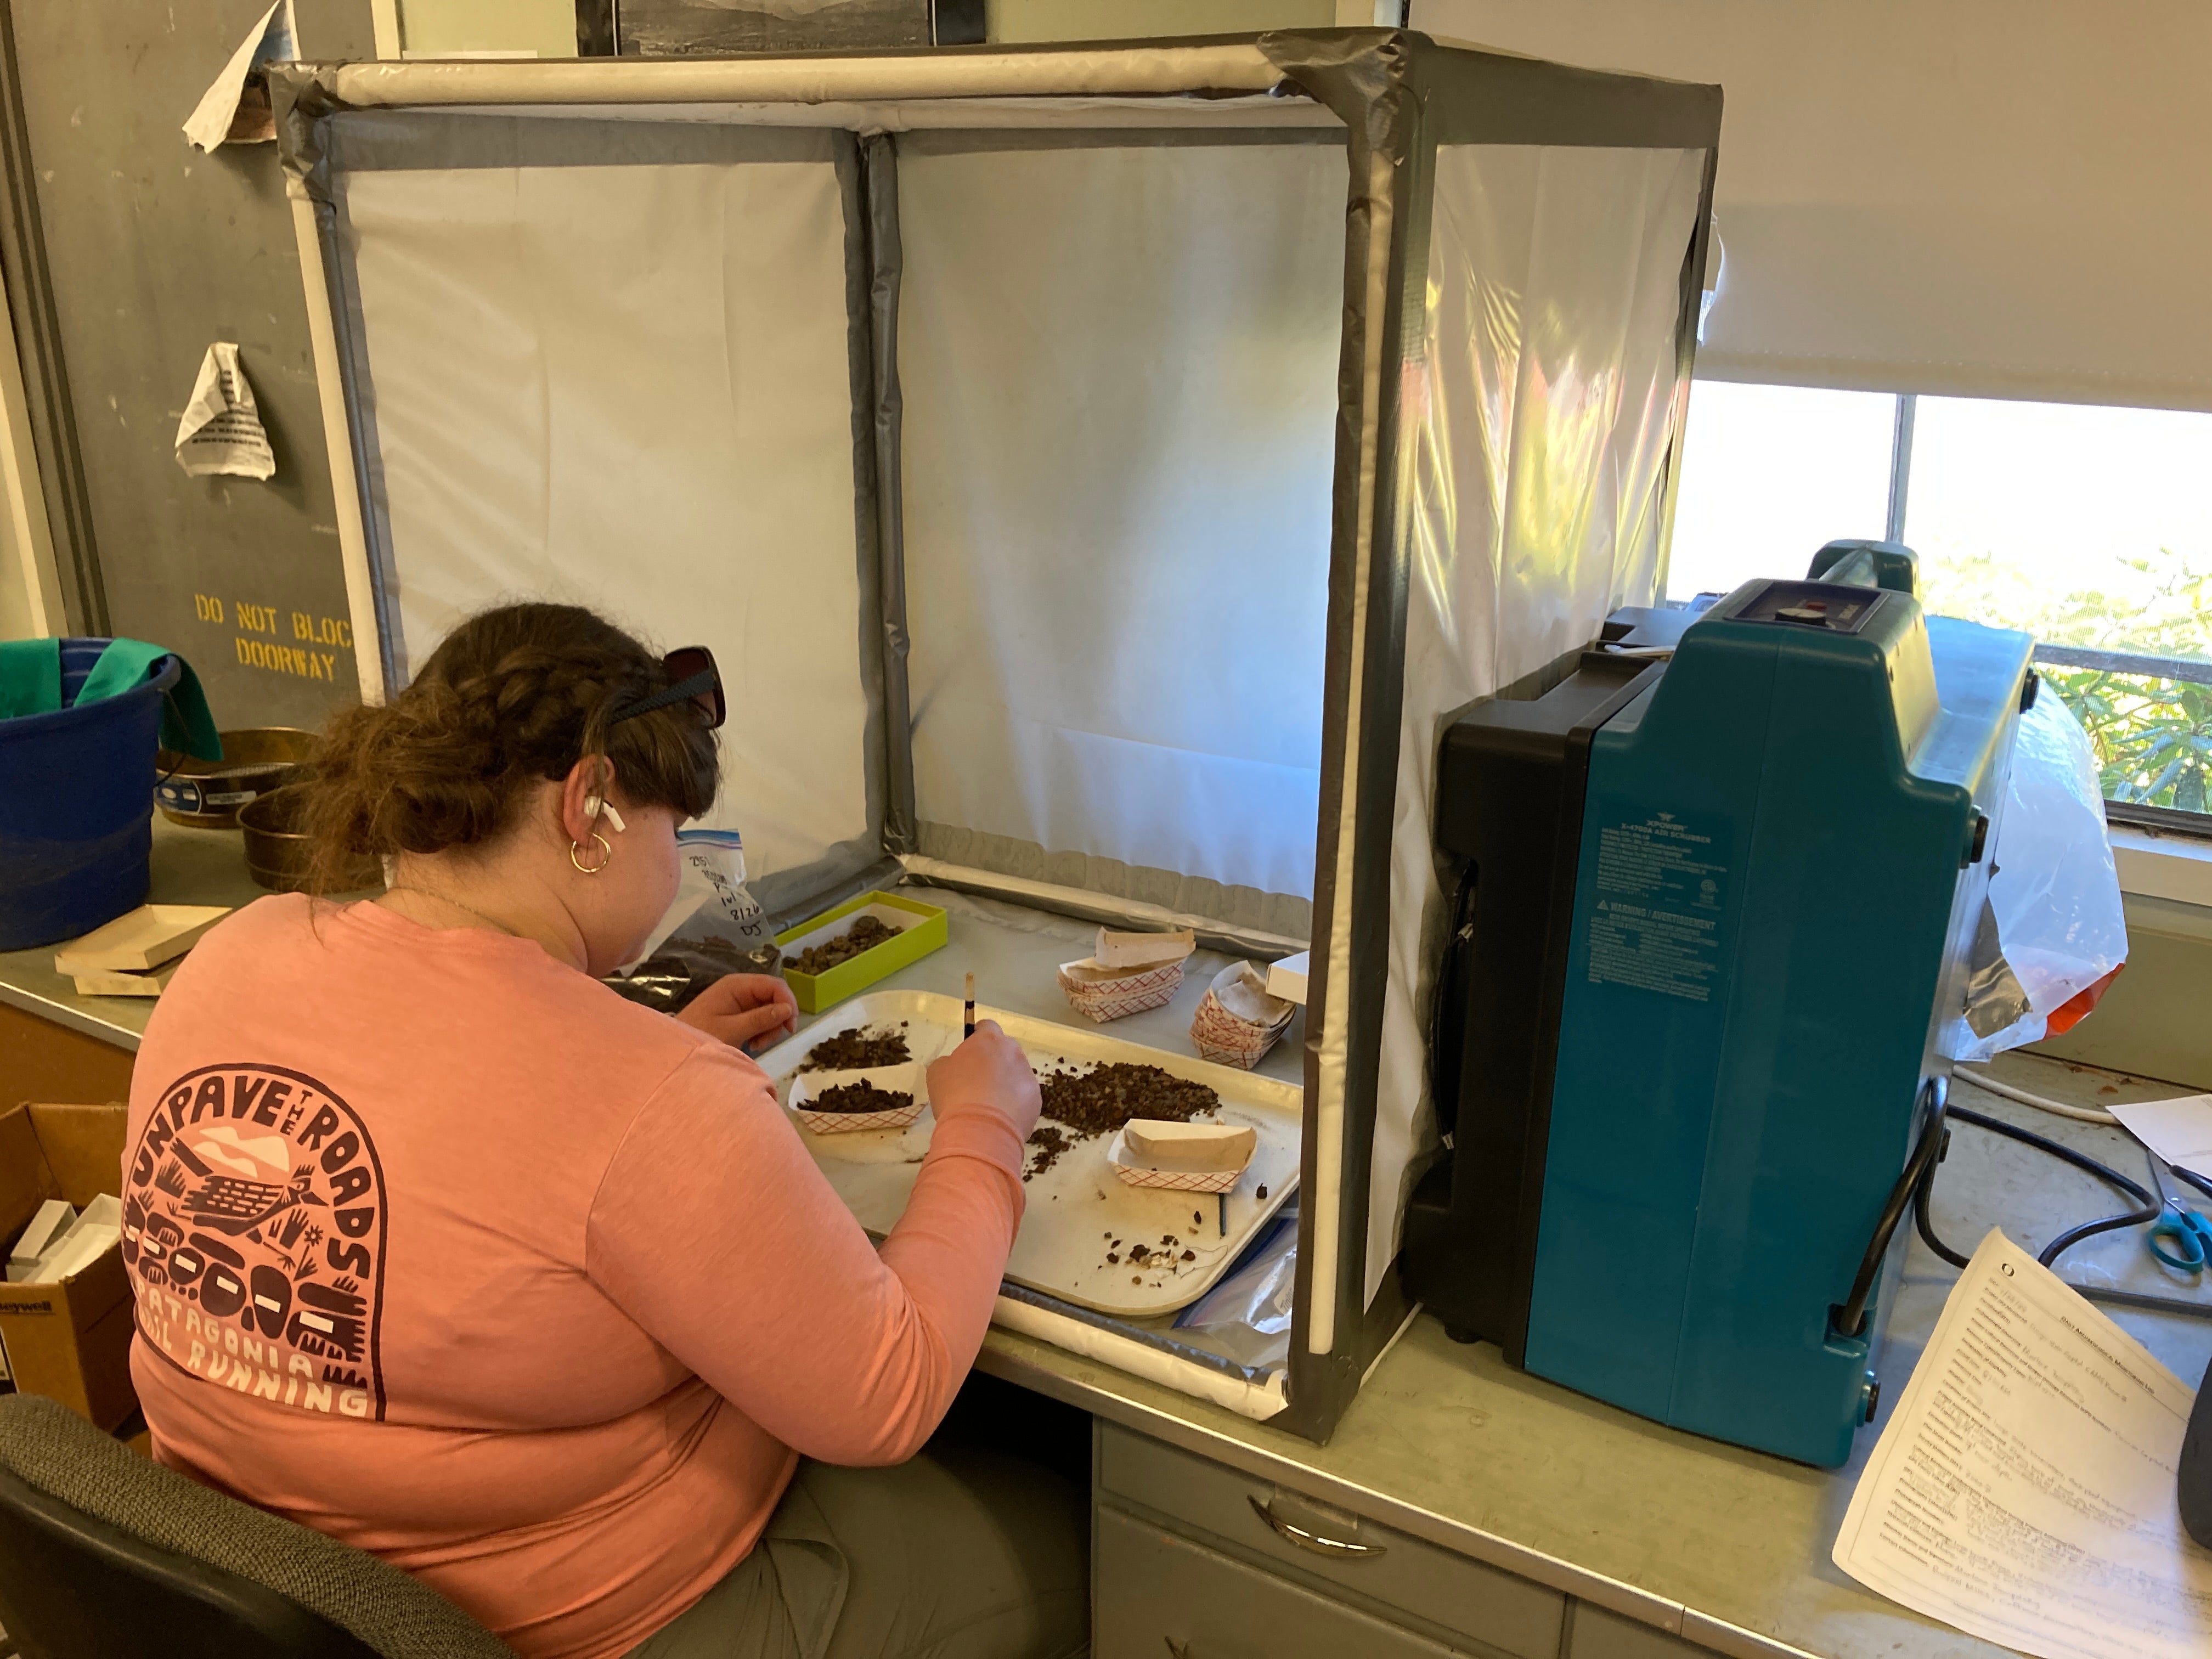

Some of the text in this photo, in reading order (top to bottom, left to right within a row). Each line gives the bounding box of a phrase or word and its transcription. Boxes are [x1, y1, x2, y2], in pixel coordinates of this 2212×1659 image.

[194, 594, 352, 648] DO NOT BLOC
[235, 637, 334, 682] DOORWAY
[132, 1075, 375, 1280] UNPAVE THE ROADS
[137, 1276, 313, 1379] PATAGONIA
[187, 1339, 368, 1418] RUNNING
